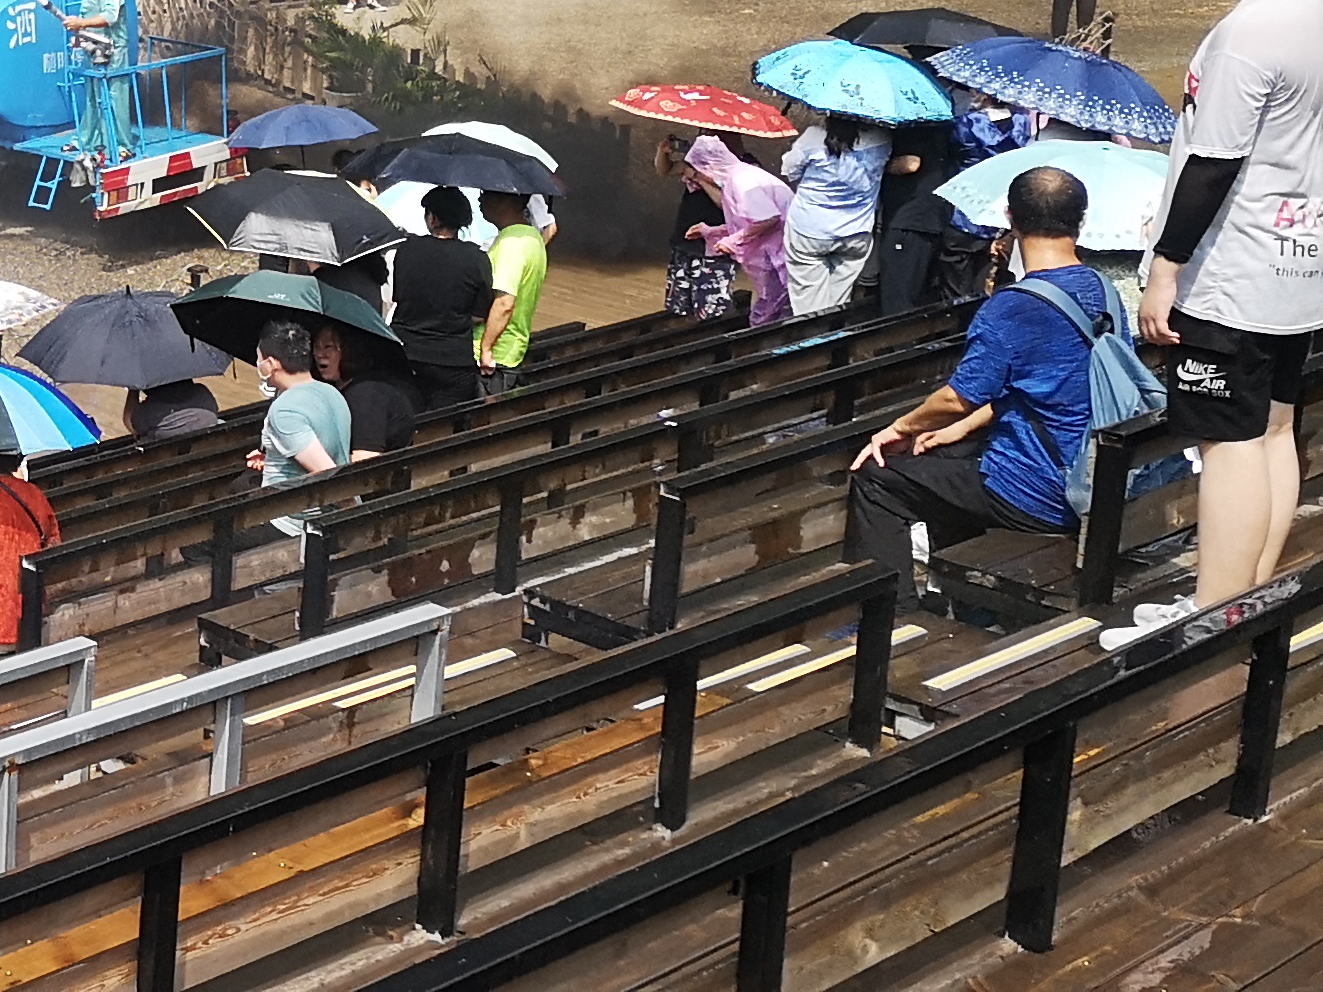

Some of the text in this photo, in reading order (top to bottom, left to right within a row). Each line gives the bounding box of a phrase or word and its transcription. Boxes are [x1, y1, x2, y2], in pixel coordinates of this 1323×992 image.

[1273, 238, 1319, 258] The
[1183, 358, 1217, 375] NIKE
[1200, 378, 1226, 390] AIR
